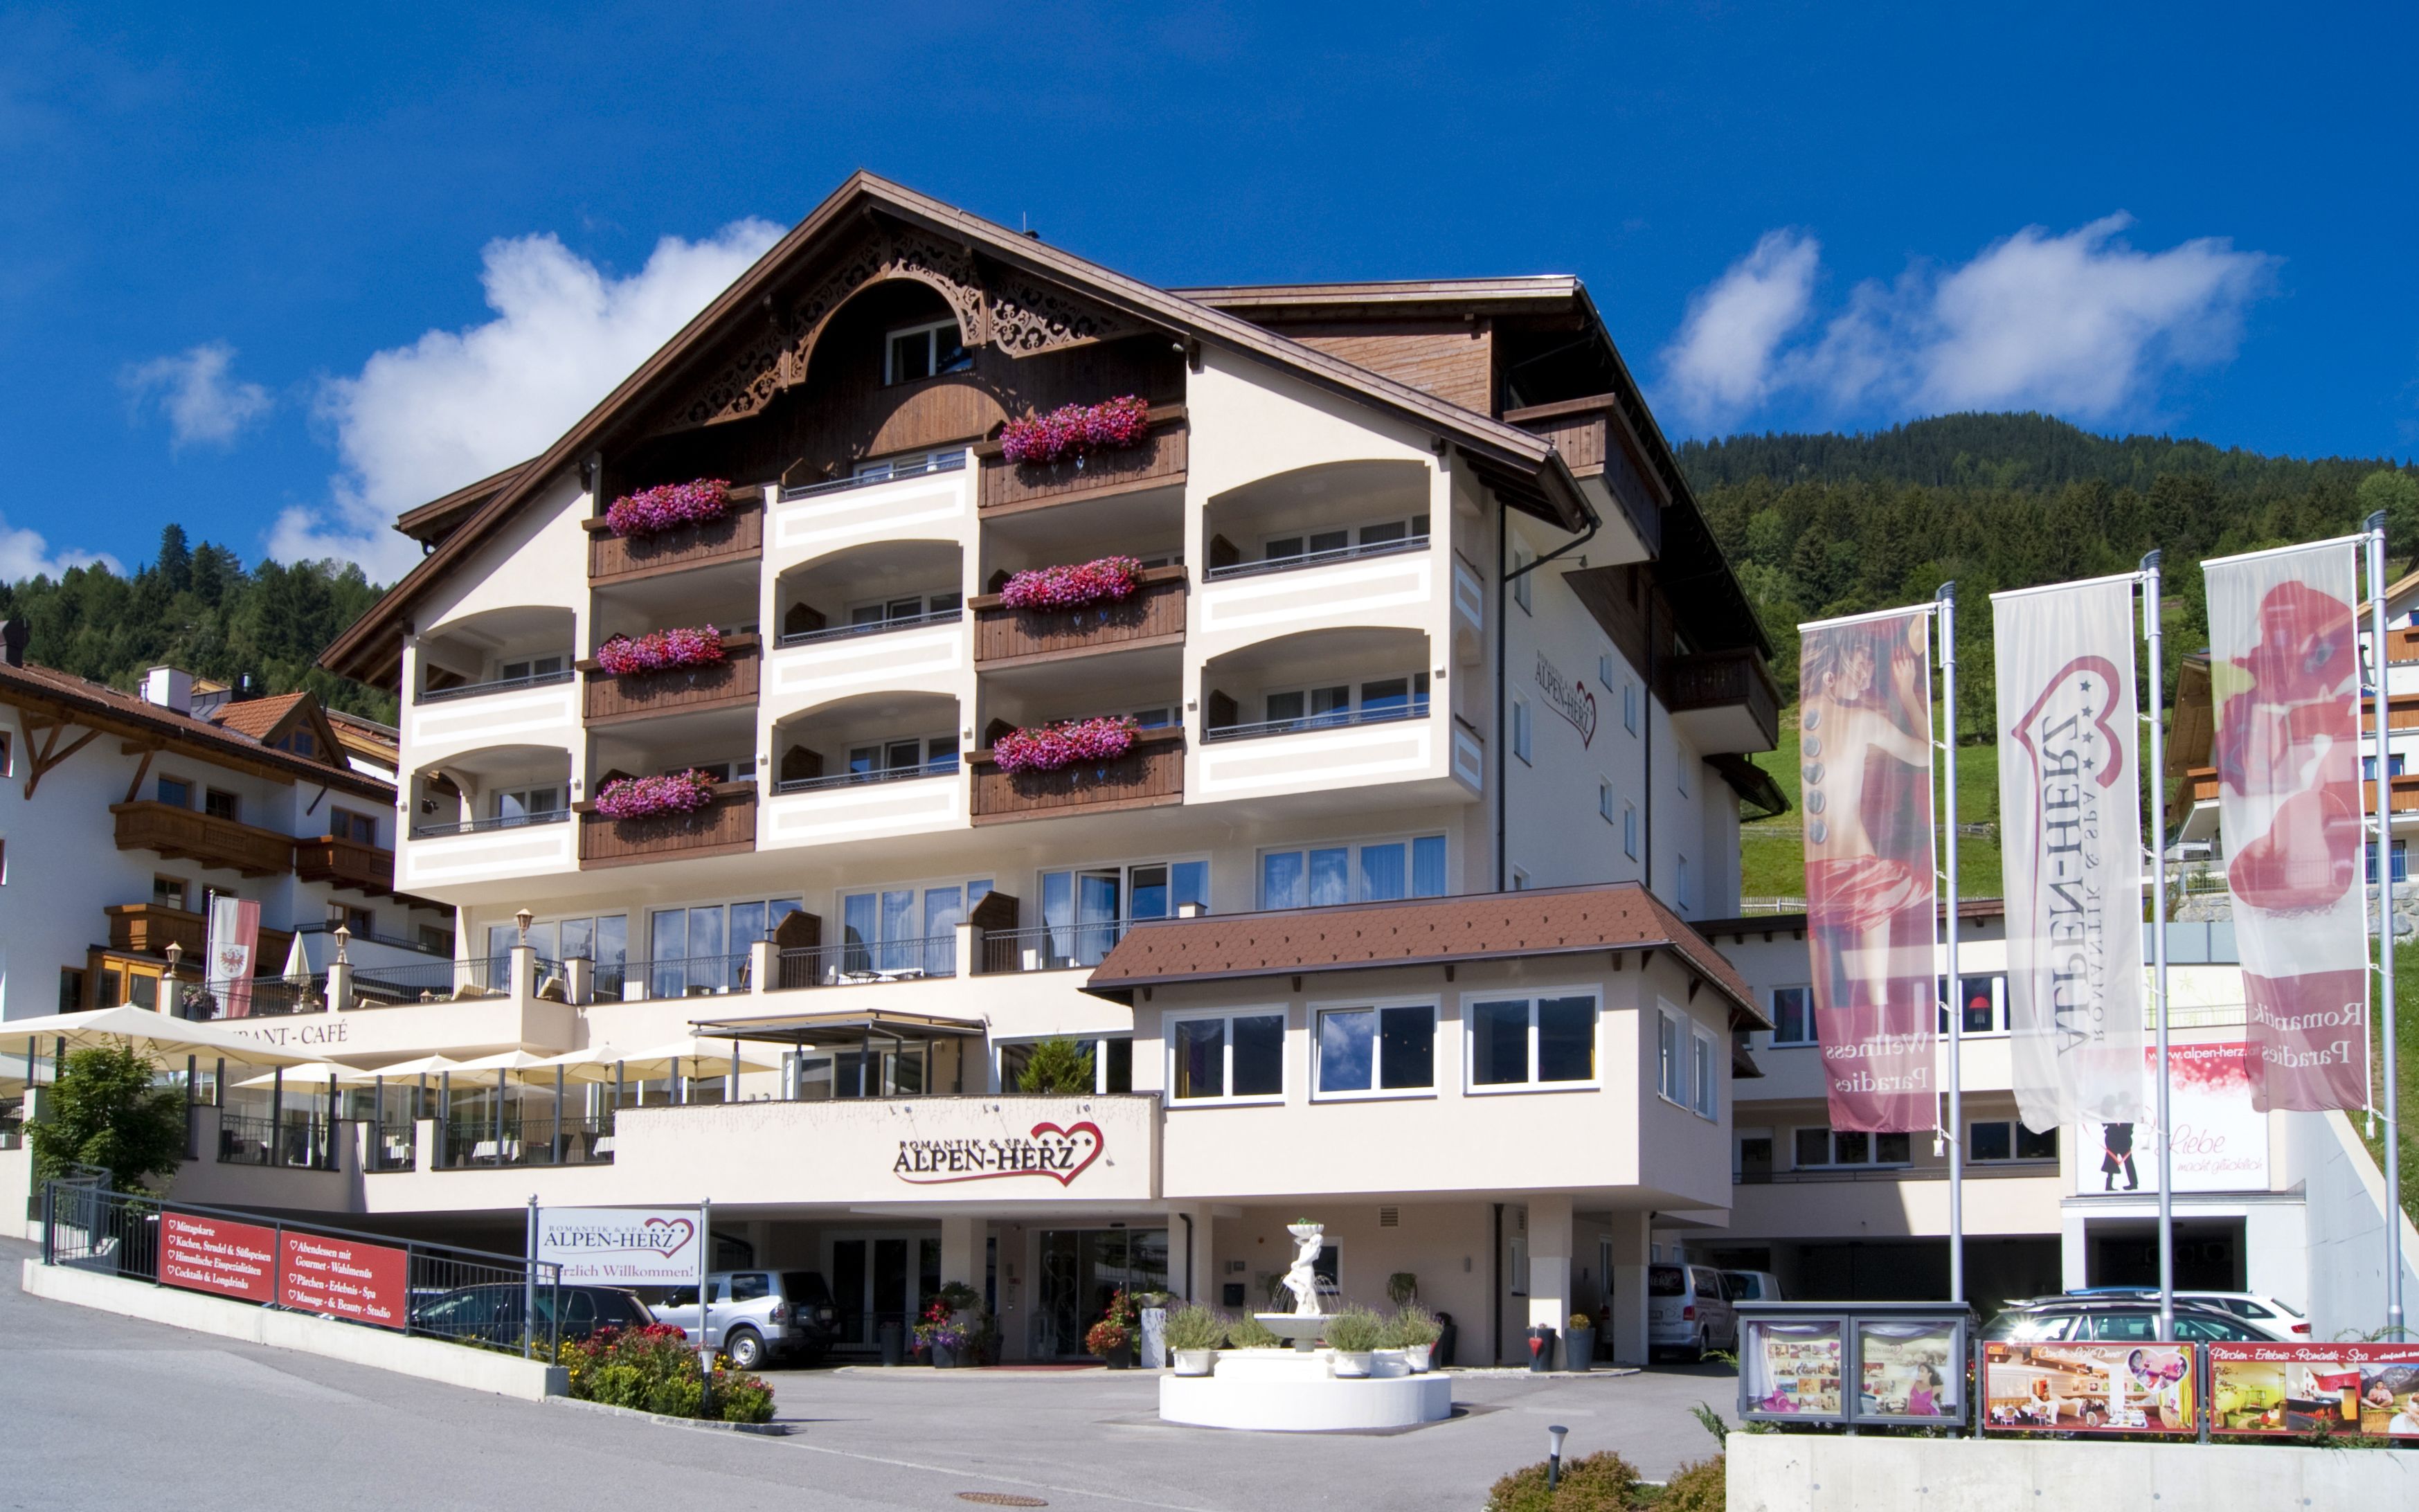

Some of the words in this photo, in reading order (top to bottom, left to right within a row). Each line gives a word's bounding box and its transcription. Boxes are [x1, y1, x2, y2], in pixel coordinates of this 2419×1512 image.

[1534, 660, 1589, 735] ALPEN-HERZ
[899, 1139, 981, 1150] ROMANTIK
[1004, 1138, 1032, 1149] SPA
[892, 1146, 1075, 1173] ALPEN-HERZ
[176, 1221, 215, 1236] Mittagskarte
[544, 1232, 674, 1248] ALPEN-HERZ
[176, 1236, 202, 1250] Kuchen,
[204, 1240, 226, 1255] Strudel
[227, 1245, 234, 1255] &
[236, 1246, 271, 1262] Süßspeisen
[297, 1241, 337, 1258] Abendessen
[339, 1249, 352, 1260] mit
[175, 1250, 213, 1267] Himmlische
[214, 1257, 262, 1276] Eisspezialitäten
[296, 1255, 326, 1270] Gourmet
[331, 1261, 372, 1279] Wahlmenüs
[602, 1264, 694, 1277] Willkommen!
[174, 1266, 203, 1281] Cocktails
[204, 1271, 210, 1282] &
[213, 1272, 249, 1290] Longdrinks
[296, 1274, 325, 1289] Pärchen
[329, 1280, 358, 1295] Erlebnis
[363, 1286, 376, 1299] Spa
[296, 1290, 323, 1307] Massage
[328, 1297, 336, 1308] &
[338, 1298, 362, 1315] Beauty
[367, 1304, 391, 1318] Studio
[2210, 1347, 2248, 1360] Pärchen
[2255, 1349, 2290, 1360] Erlebnis
[2296, 1347, 2339, 1360] Romantik
[2346, 1349, 2368, 1363] Spa
